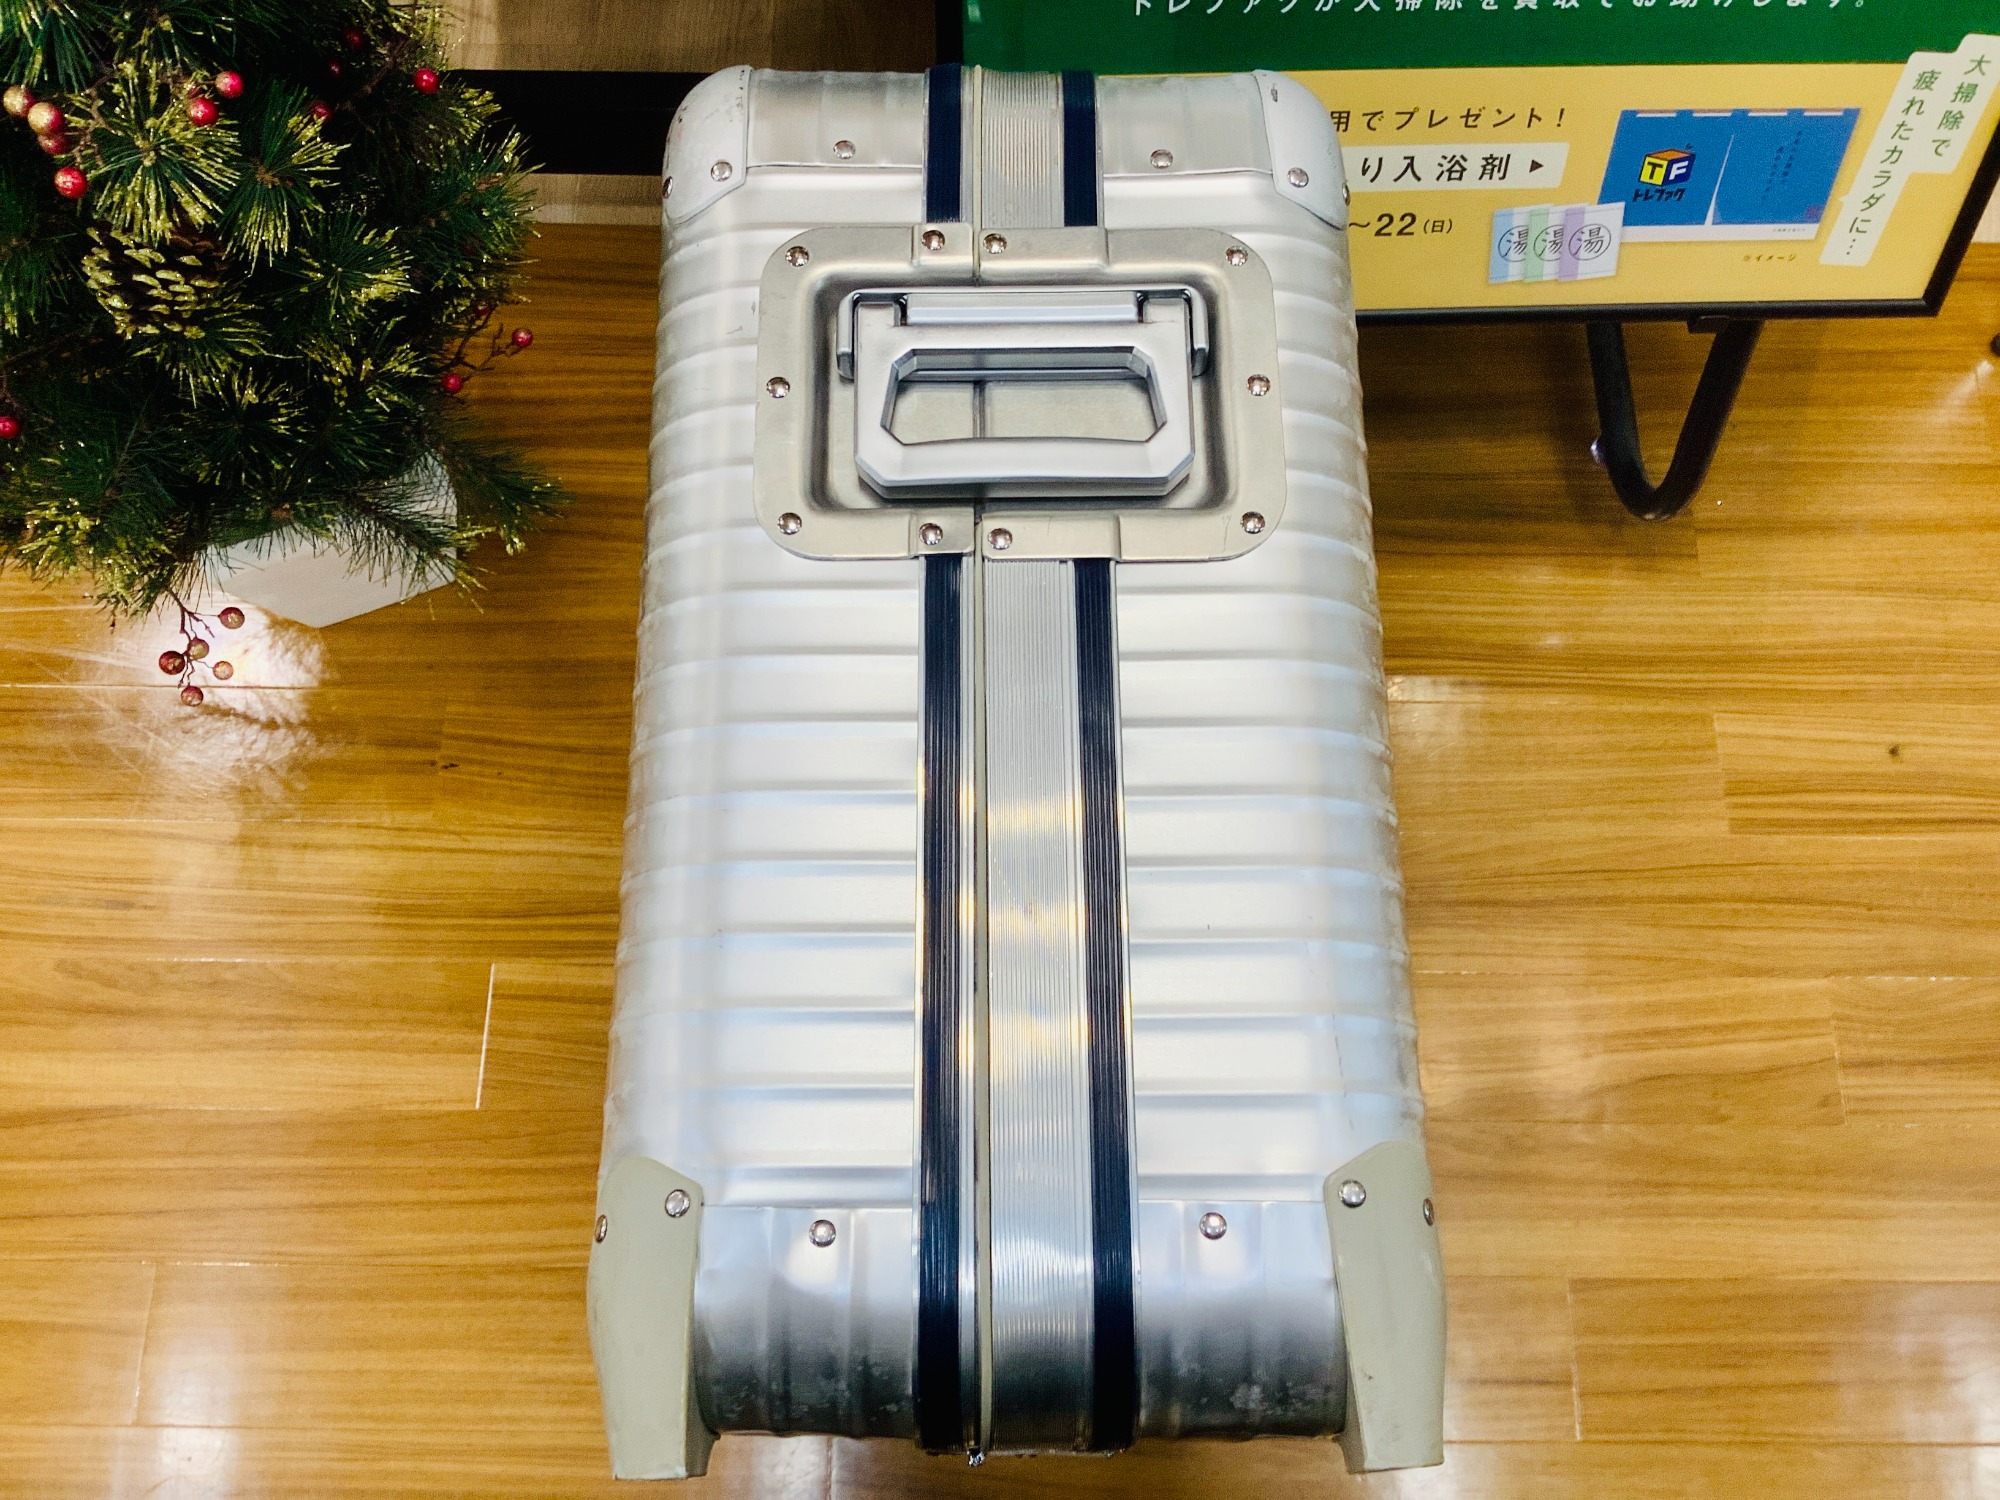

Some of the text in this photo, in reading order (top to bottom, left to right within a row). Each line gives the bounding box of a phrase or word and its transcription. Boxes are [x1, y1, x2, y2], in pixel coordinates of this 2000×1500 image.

[1932, 54, 1991, 157] 大掃除で
[1361, 153, 1511, 183] り入浴剤
[1647, 160, 1689, 181] TF
[1632, 187, 1686, 202] トレファク
[1574, 226, 1605, 256] 湯
